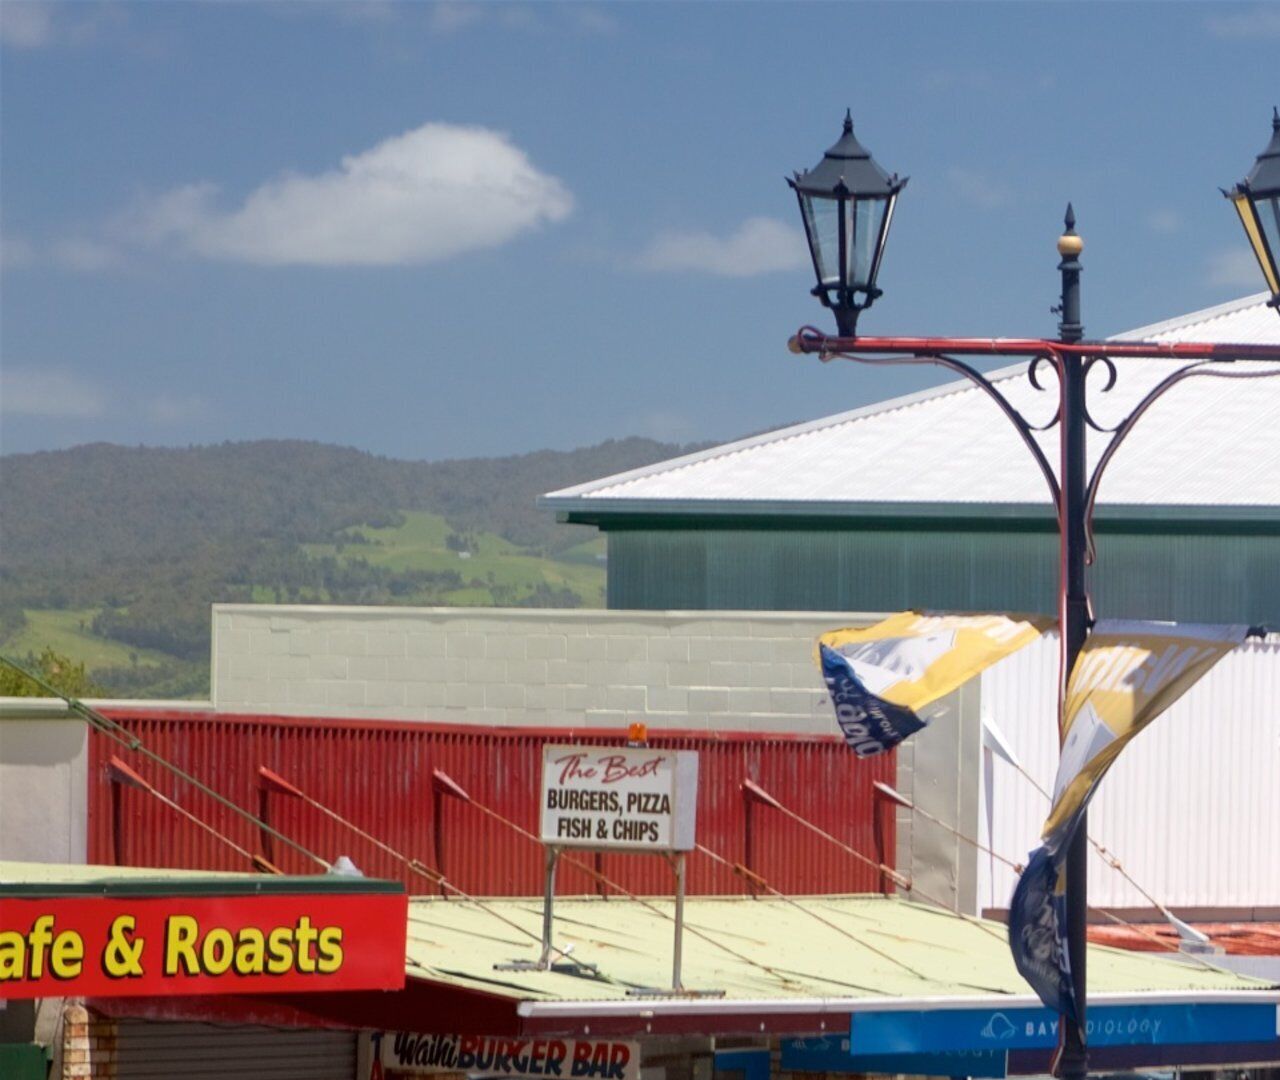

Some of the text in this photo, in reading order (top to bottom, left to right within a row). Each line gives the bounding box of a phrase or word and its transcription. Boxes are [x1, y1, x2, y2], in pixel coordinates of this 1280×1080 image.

[555, 753, 666, 785] The Best
[547, 789, 671, 817] BURGERS, PIZZA
[557, 817, 659, 842] FISH & CHIPS
[0, 914, 345, 979] afe & Roasts
[1026, 1019, 1163, 1037] BAY DIOLOGY
[457, 1034, 568, 1077] BURGER
[570, 1037, 631, 1080] BAR
